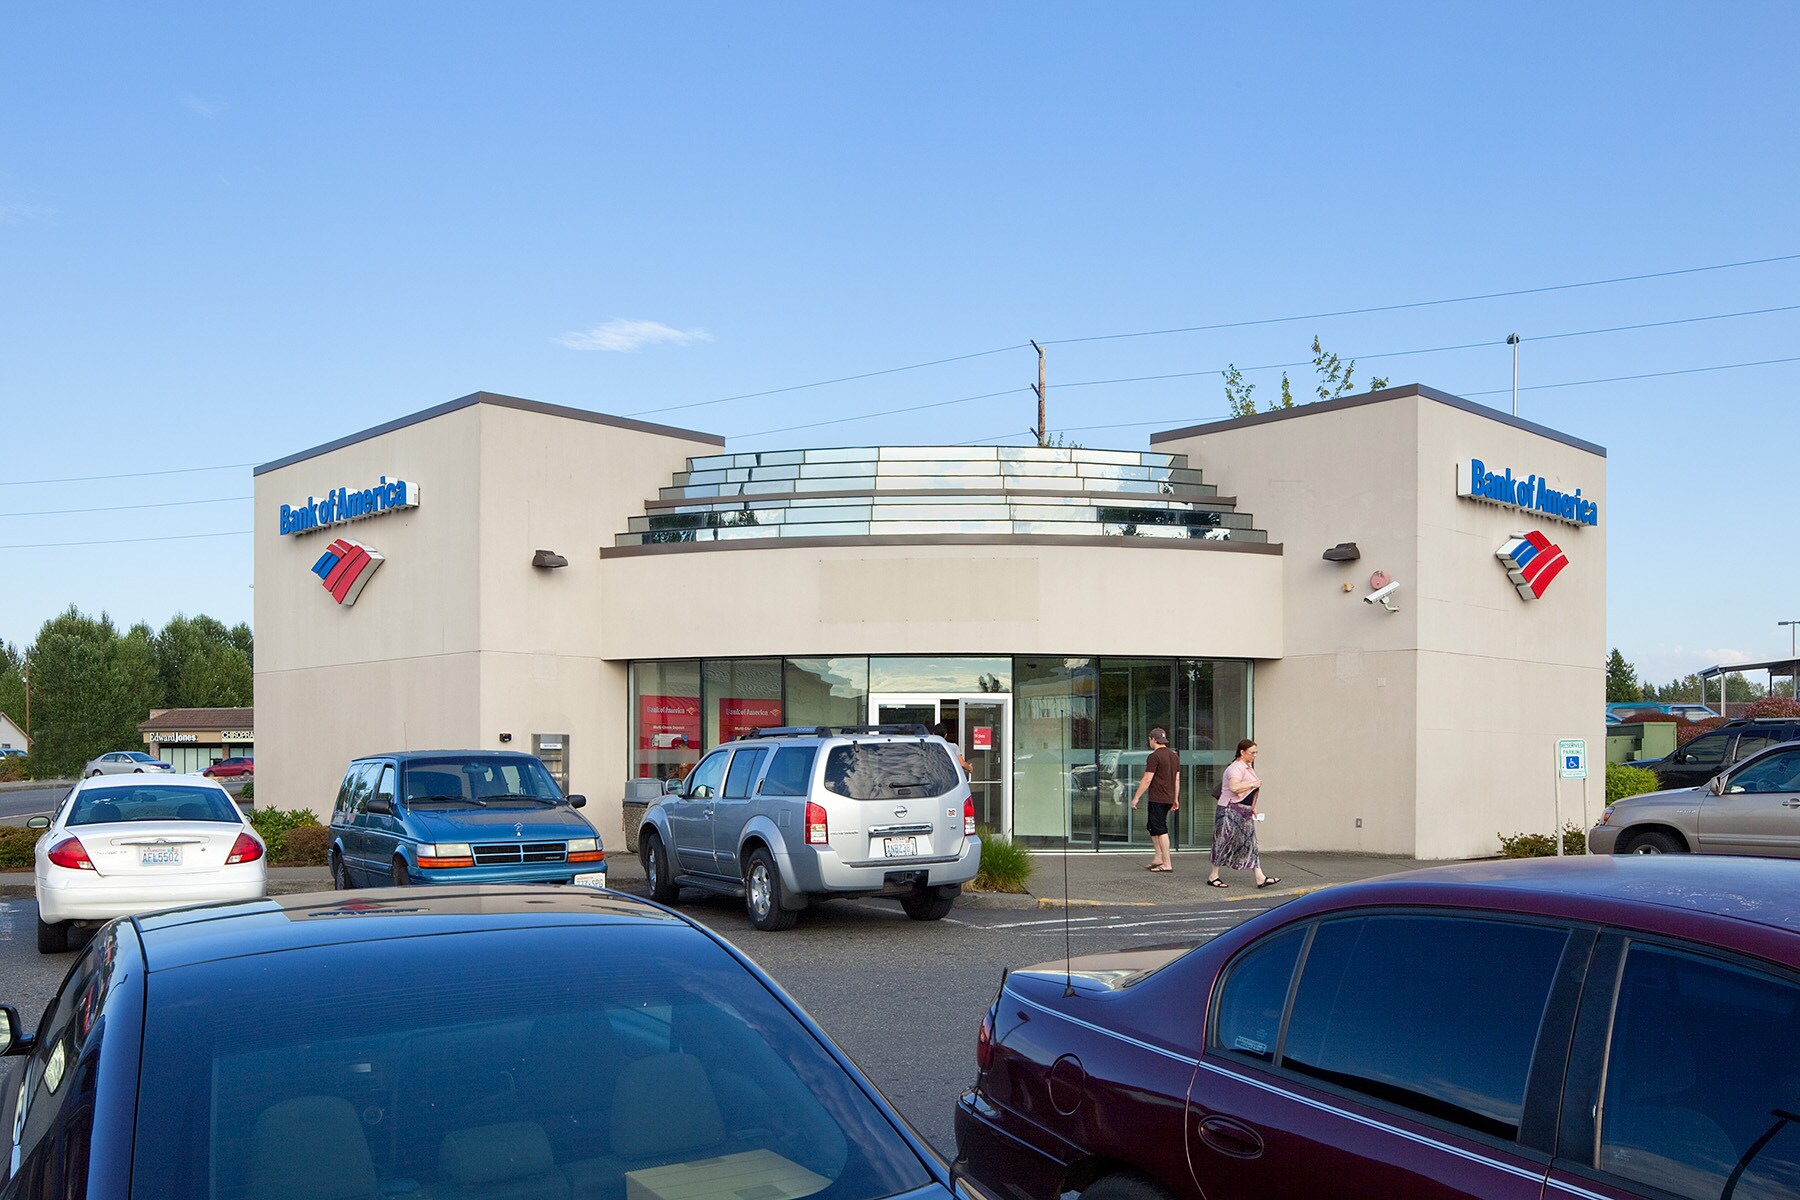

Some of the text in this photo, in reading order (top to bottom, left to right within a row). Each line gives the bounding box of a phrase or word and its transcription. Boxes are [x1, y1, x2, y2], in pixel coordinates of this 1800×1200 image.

[280, 475, 407, 535] Bank of America
[1471, 458, 1598, 526] Bank of America
